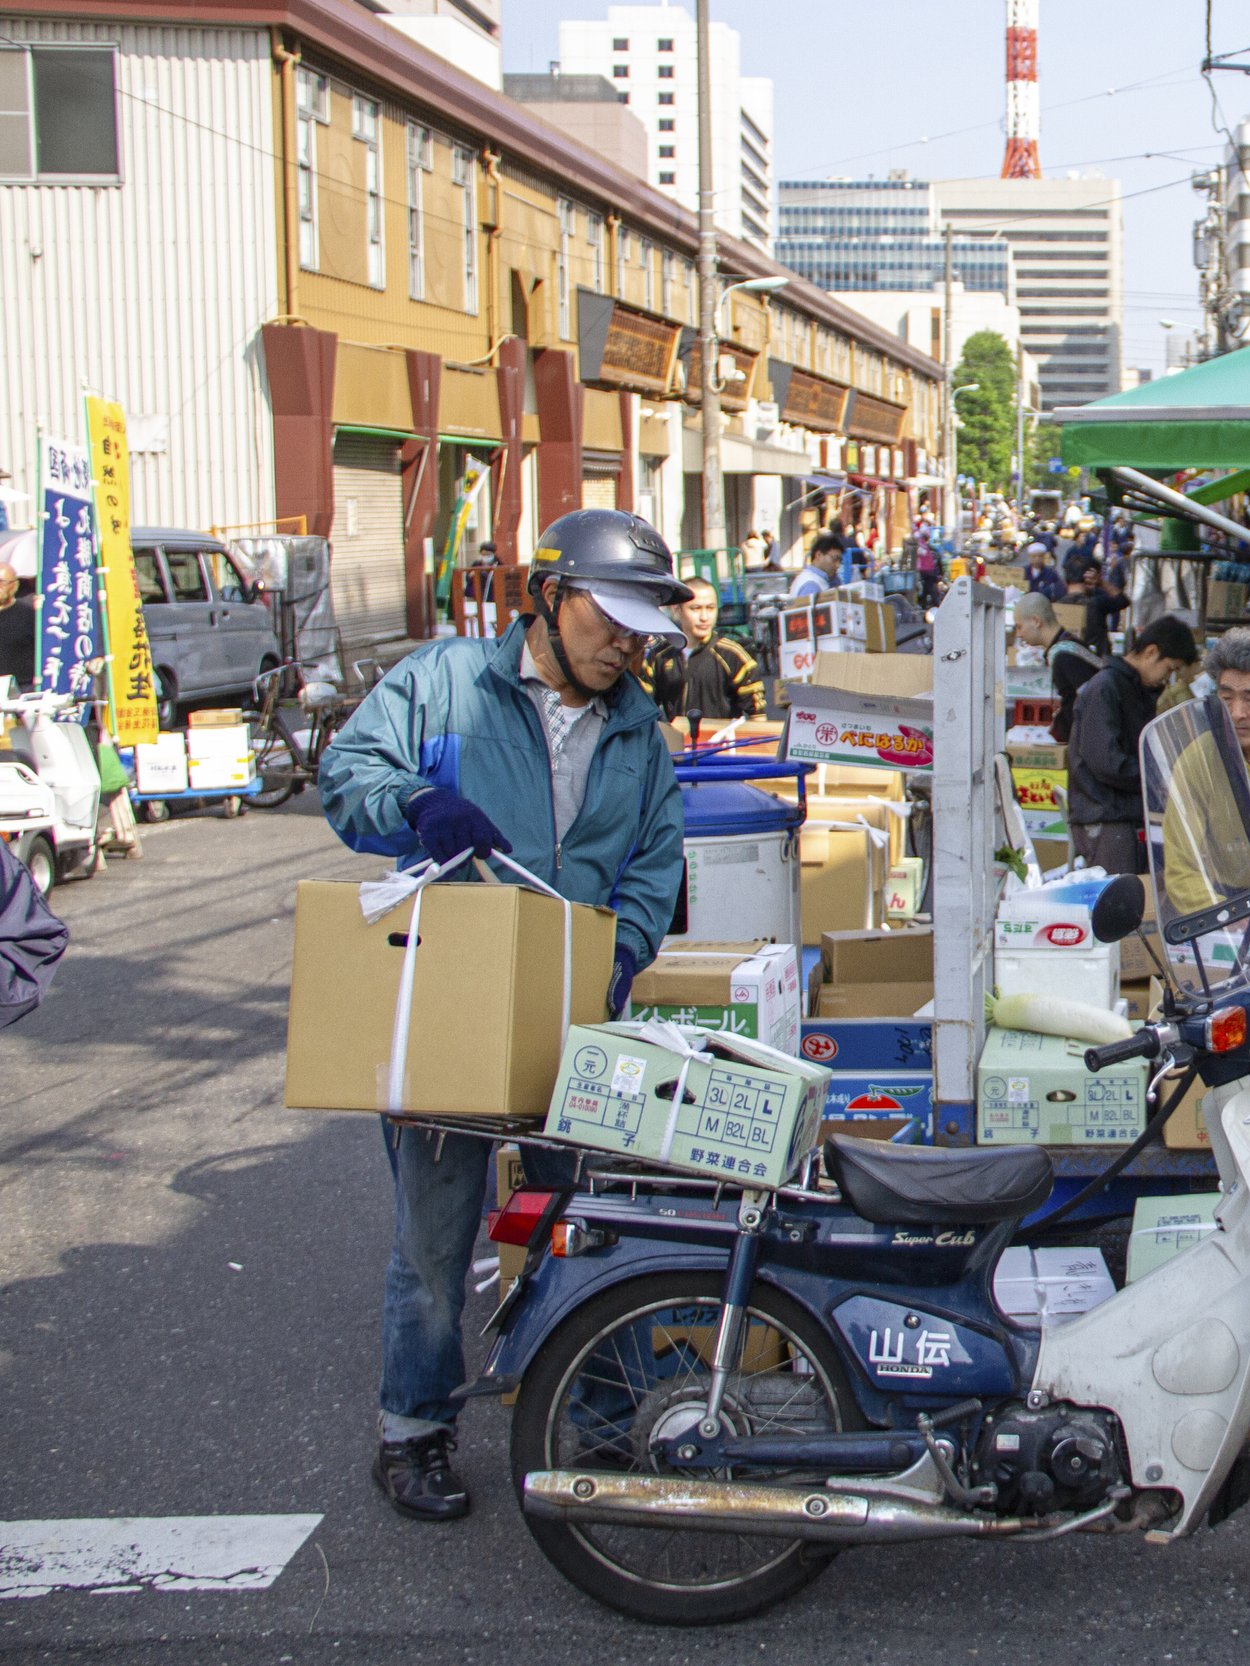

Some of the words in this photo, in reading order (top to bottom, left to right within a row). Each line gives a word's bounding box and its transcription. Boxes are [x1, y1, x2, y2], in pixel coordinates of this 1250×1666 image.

[840, 730, 924, 753] べにはるか
[710, 1087, 727, 1105] 3L
[734, 1093, 751, 1110] 2L
[762, 1099, 772, 1115] L
[1106, 1089, 1117, 1101] 2L
[1126, 1090, 1133, 1100] L
[1090, 1110, 1099, 1120] M
[1123, 1109, 1136, 1120] BL
[705, 1116, 719, 1132] M
[725, 1121, 746, 1139] B2L
[751, 1127, 769, 1144] BL
[1085, 1128, 1139, 1138] 野菜連合会
[690, 1147, 767, 1176] 野菜連合会
[891, 1231, 933, 1246] Super
[935, 1230, 975, 1246] Cub
[869, 1327, 951, 1367] 山伝
[880, 1364, 930, 1374] HONDA
